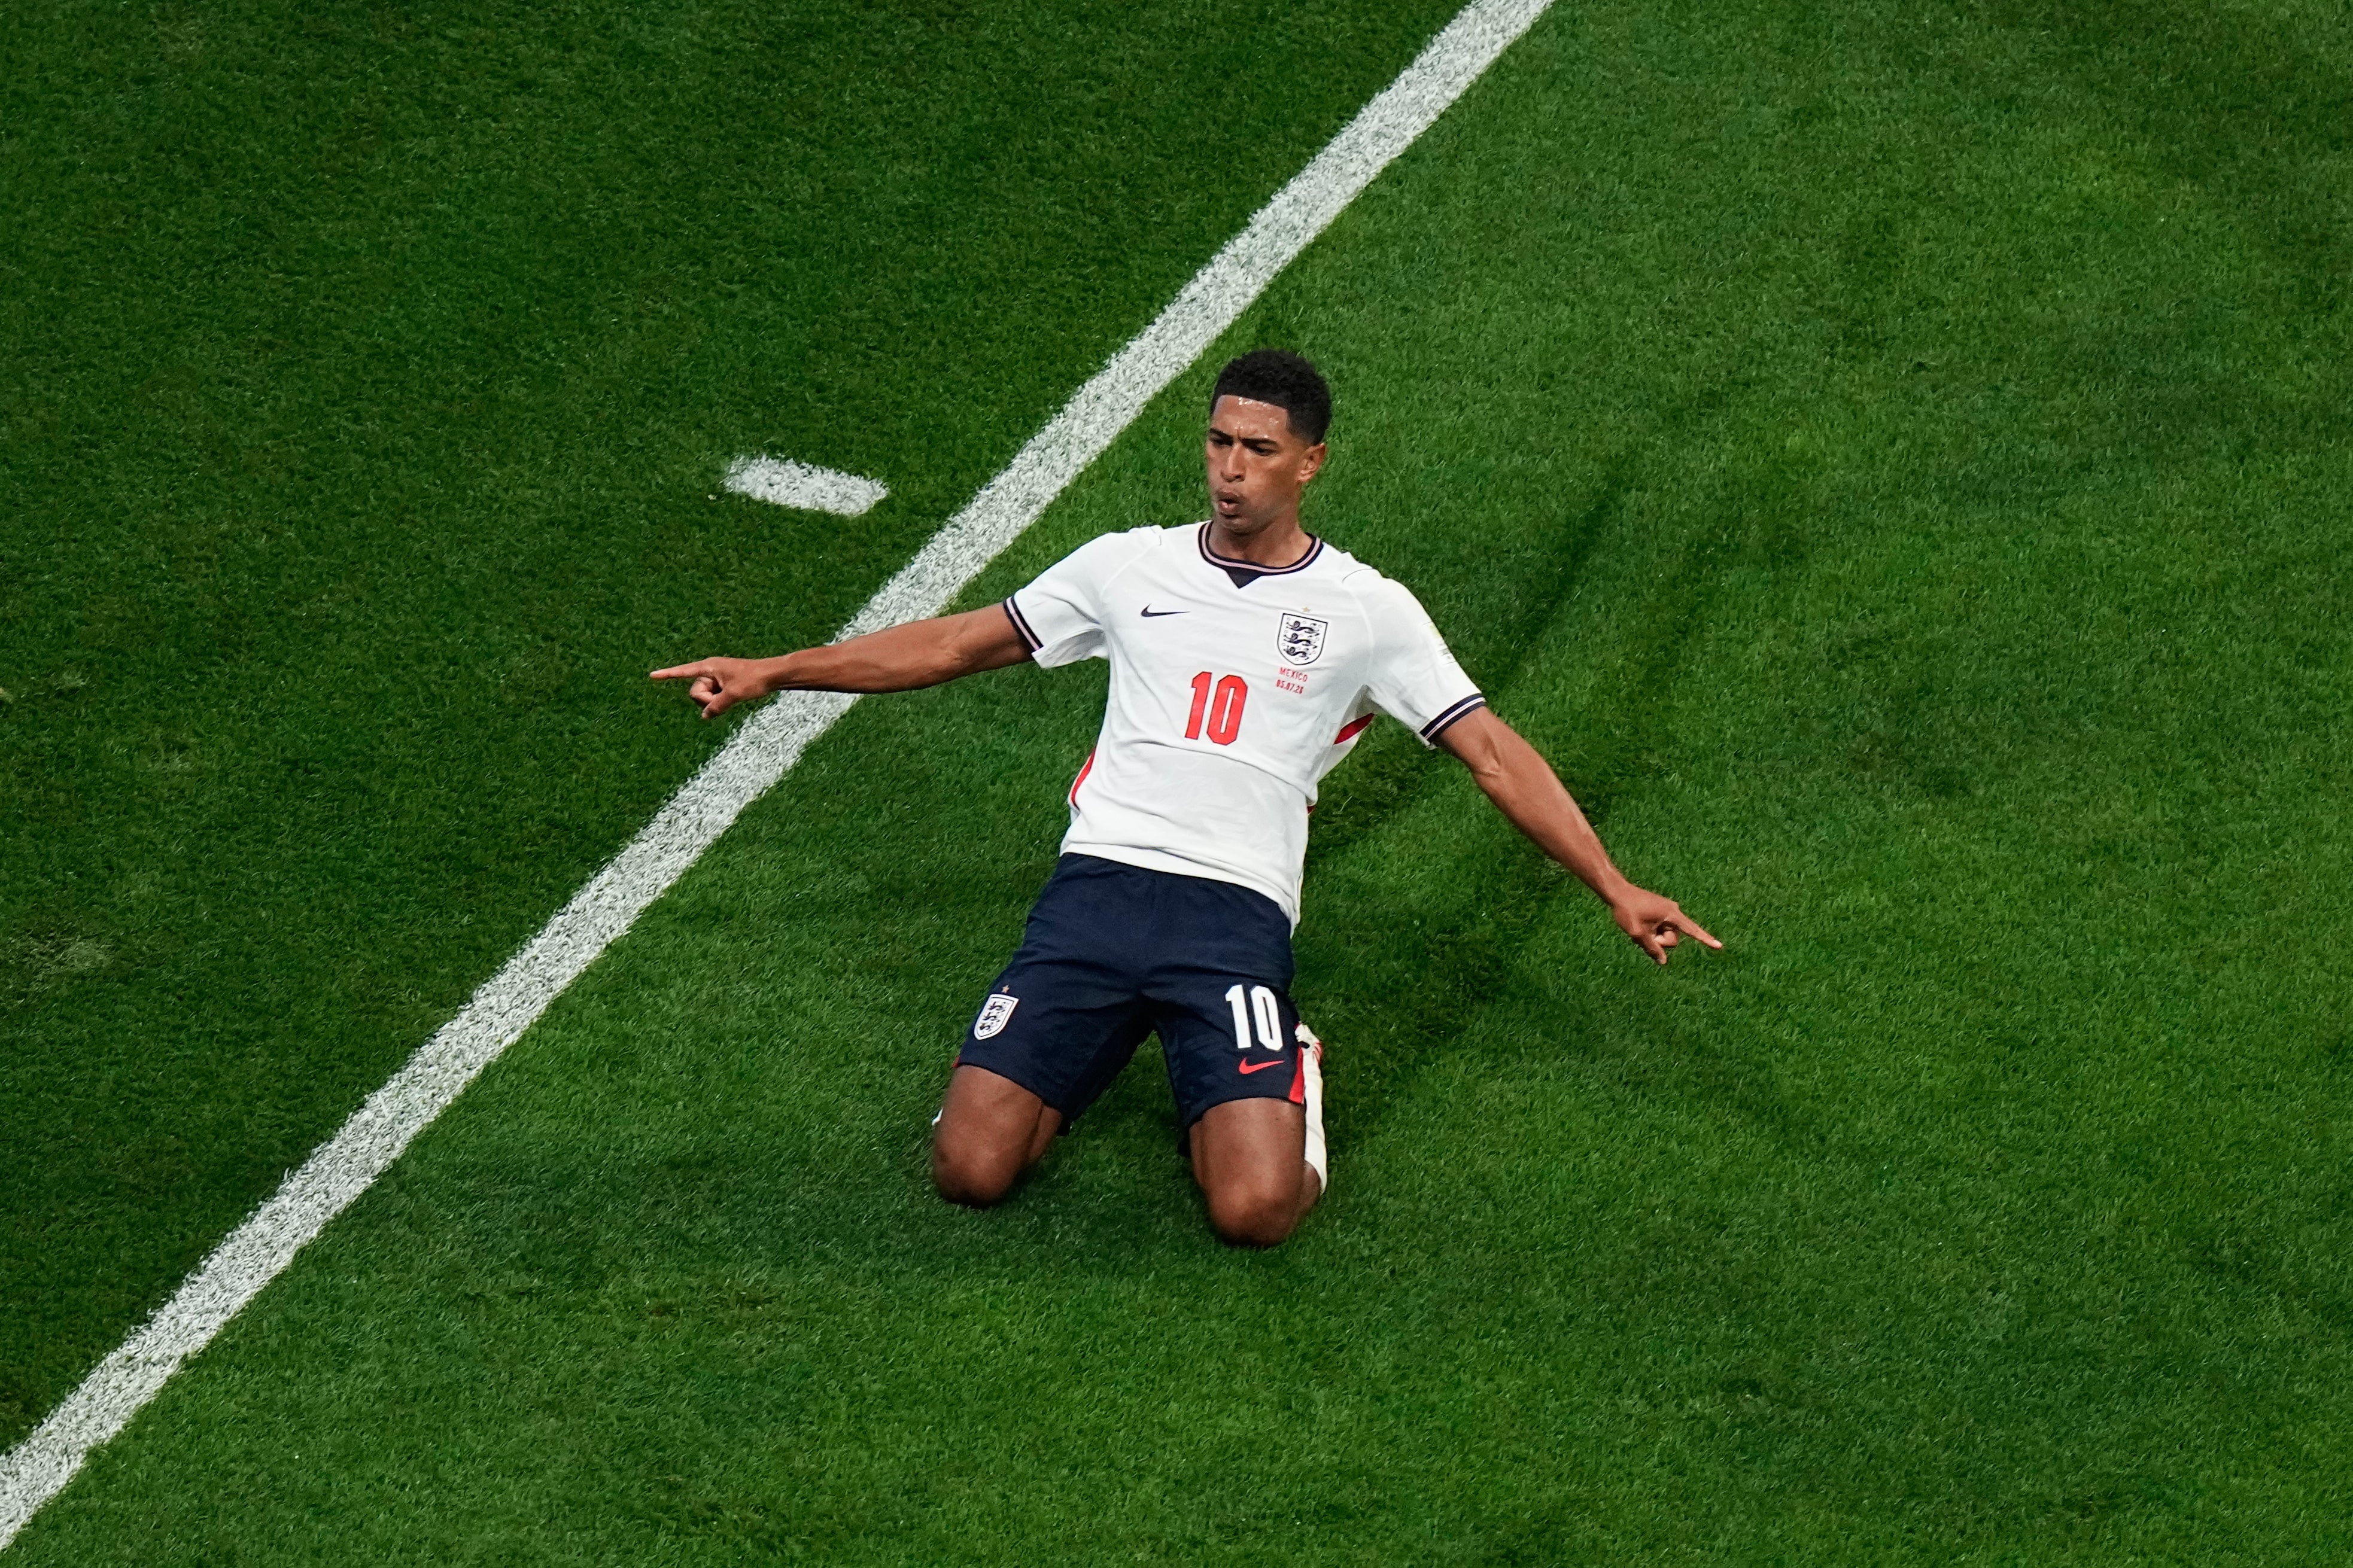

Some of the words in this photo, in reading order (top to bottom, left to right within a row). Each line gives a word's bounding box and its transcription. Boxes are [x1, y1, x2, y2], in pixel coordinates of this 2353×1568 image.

[1185, 671, 1248, 745] 10
[1279, 667, 1308, 682] MEXICO
[1225, 984, 1283, 1051] 10
